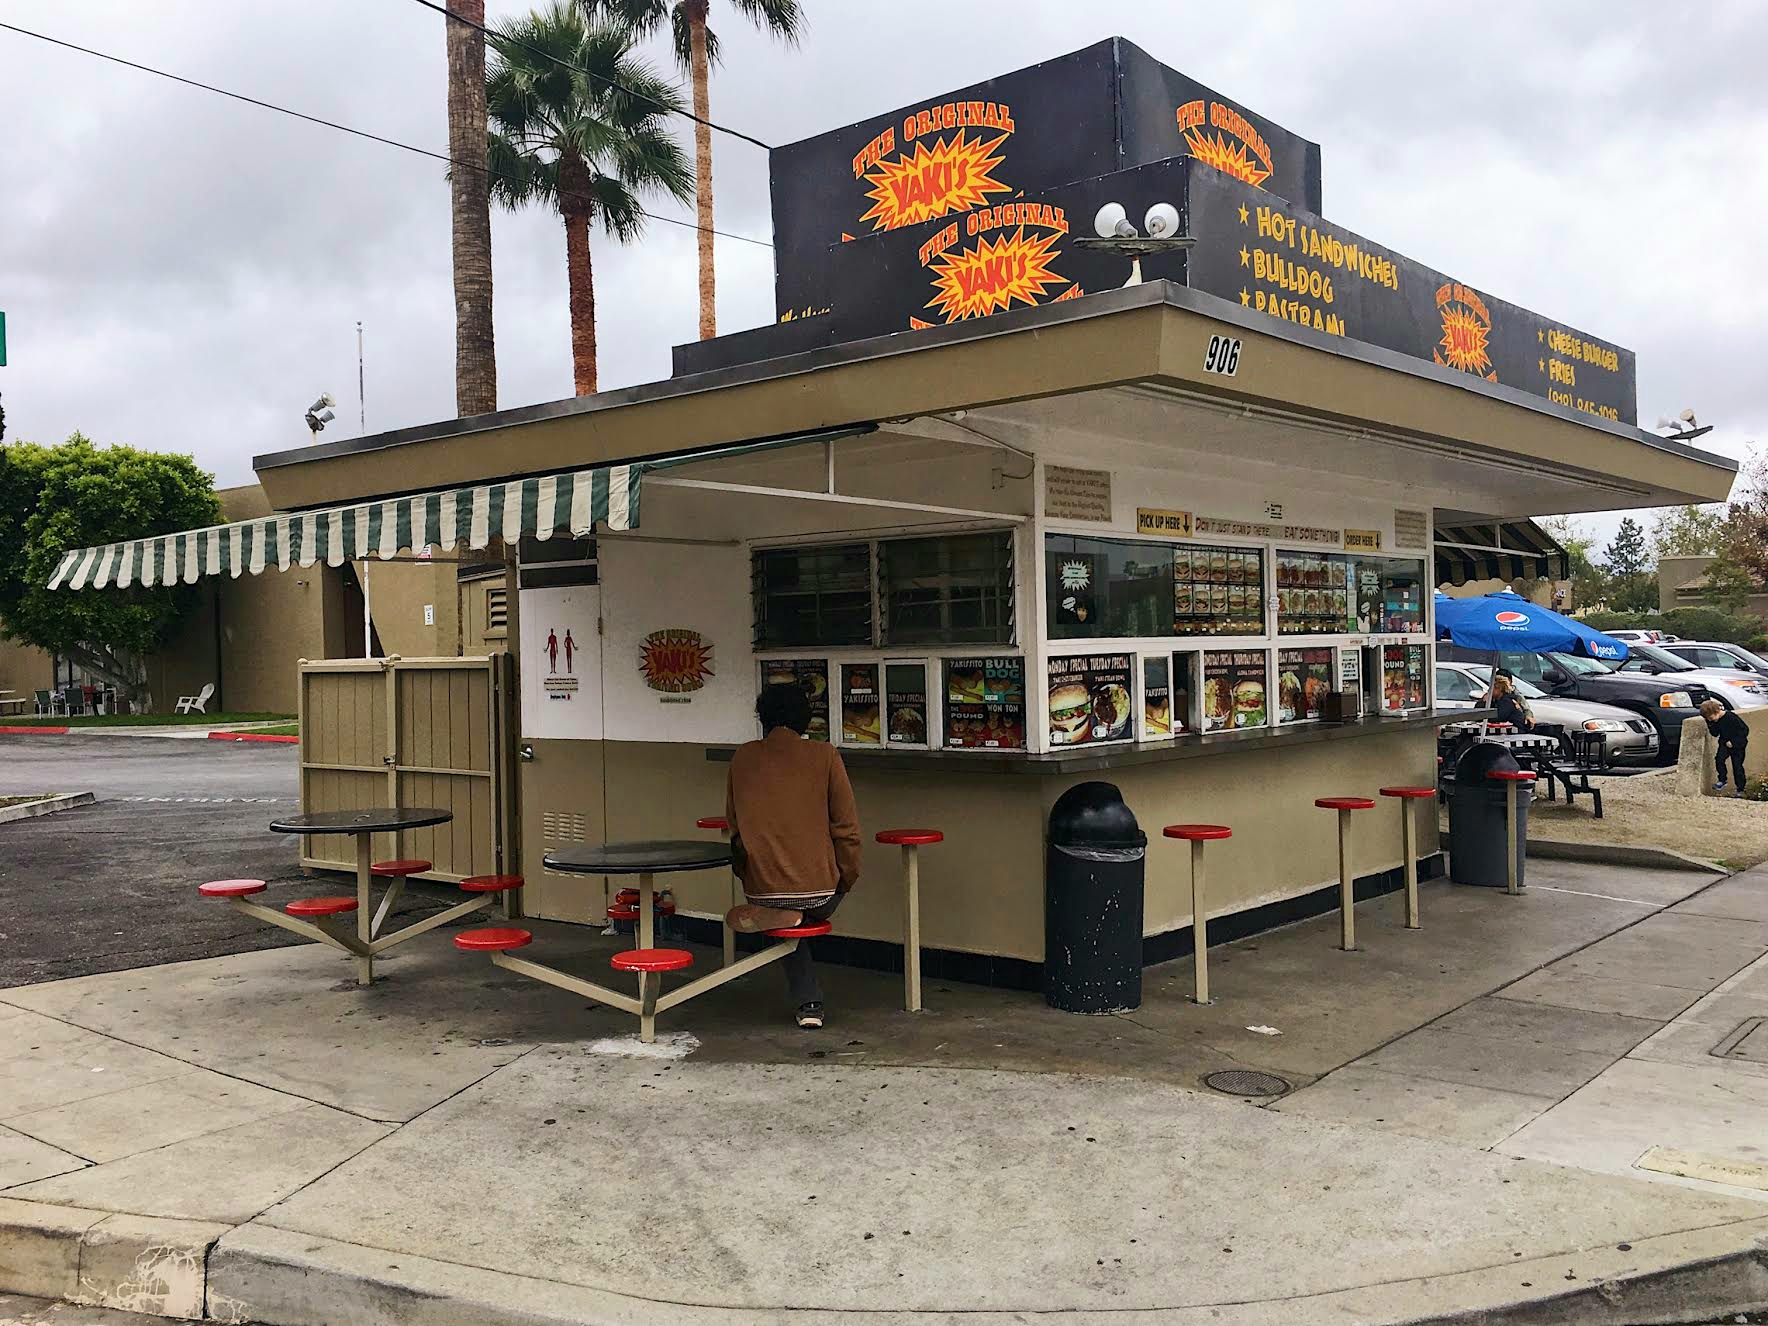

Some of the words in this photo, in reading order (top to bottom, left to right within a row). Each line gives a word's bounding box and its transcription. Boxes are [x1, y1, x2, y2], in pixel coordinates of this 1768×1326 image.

[853, 127, 895, 180] THE
[904, 101, 1014, 141] ORIGINAL
[1176, 100, 1205, 132] THE
[1210, 101, 1273, 176] ORIGINAL
[890, 156, 970, 212] YAKI'S
[919, 222, 959, 268] THE
[967, 202, 1069, 236] ORIGINAL
[1256, 206, 1296, 248] HOT
[1301, 225, 1398, 290] SANDWICHES
[954, 250, 1028, 302] YAKI'S
[1254, 248, 1334, 304] BULLDOG
[1206, 336, 1240, 374] 906
[1548, 329, 1582, 359] CHEESE
[1583, 341, 1618, 373] BURGER
[1549, 358, 1576, 386] FRIES
[1140, 514, 1155, 529] PICK
[1155, 515, 1164, 528] UP
[1165, 516, 1180, 530] HERE
[1284, 526, 1298, 539] EAT
[1346, 534, 1361, 546] ORDER
[1362, 535, 1373, 547] HERE
[950, 660, 983, 668] YAKISSITO
[985, 658, 1019, 669] BULL
[985, 668, 1020, 679] DOG
[1385, 660, 1405, 669] OUND
[843, 694, 878, 704] YAKISSITO
[906, 693, 926, 703] SPECIAL
[987, 704, 1003, 713] WON
[1005, 704, 1019, 713] TON
